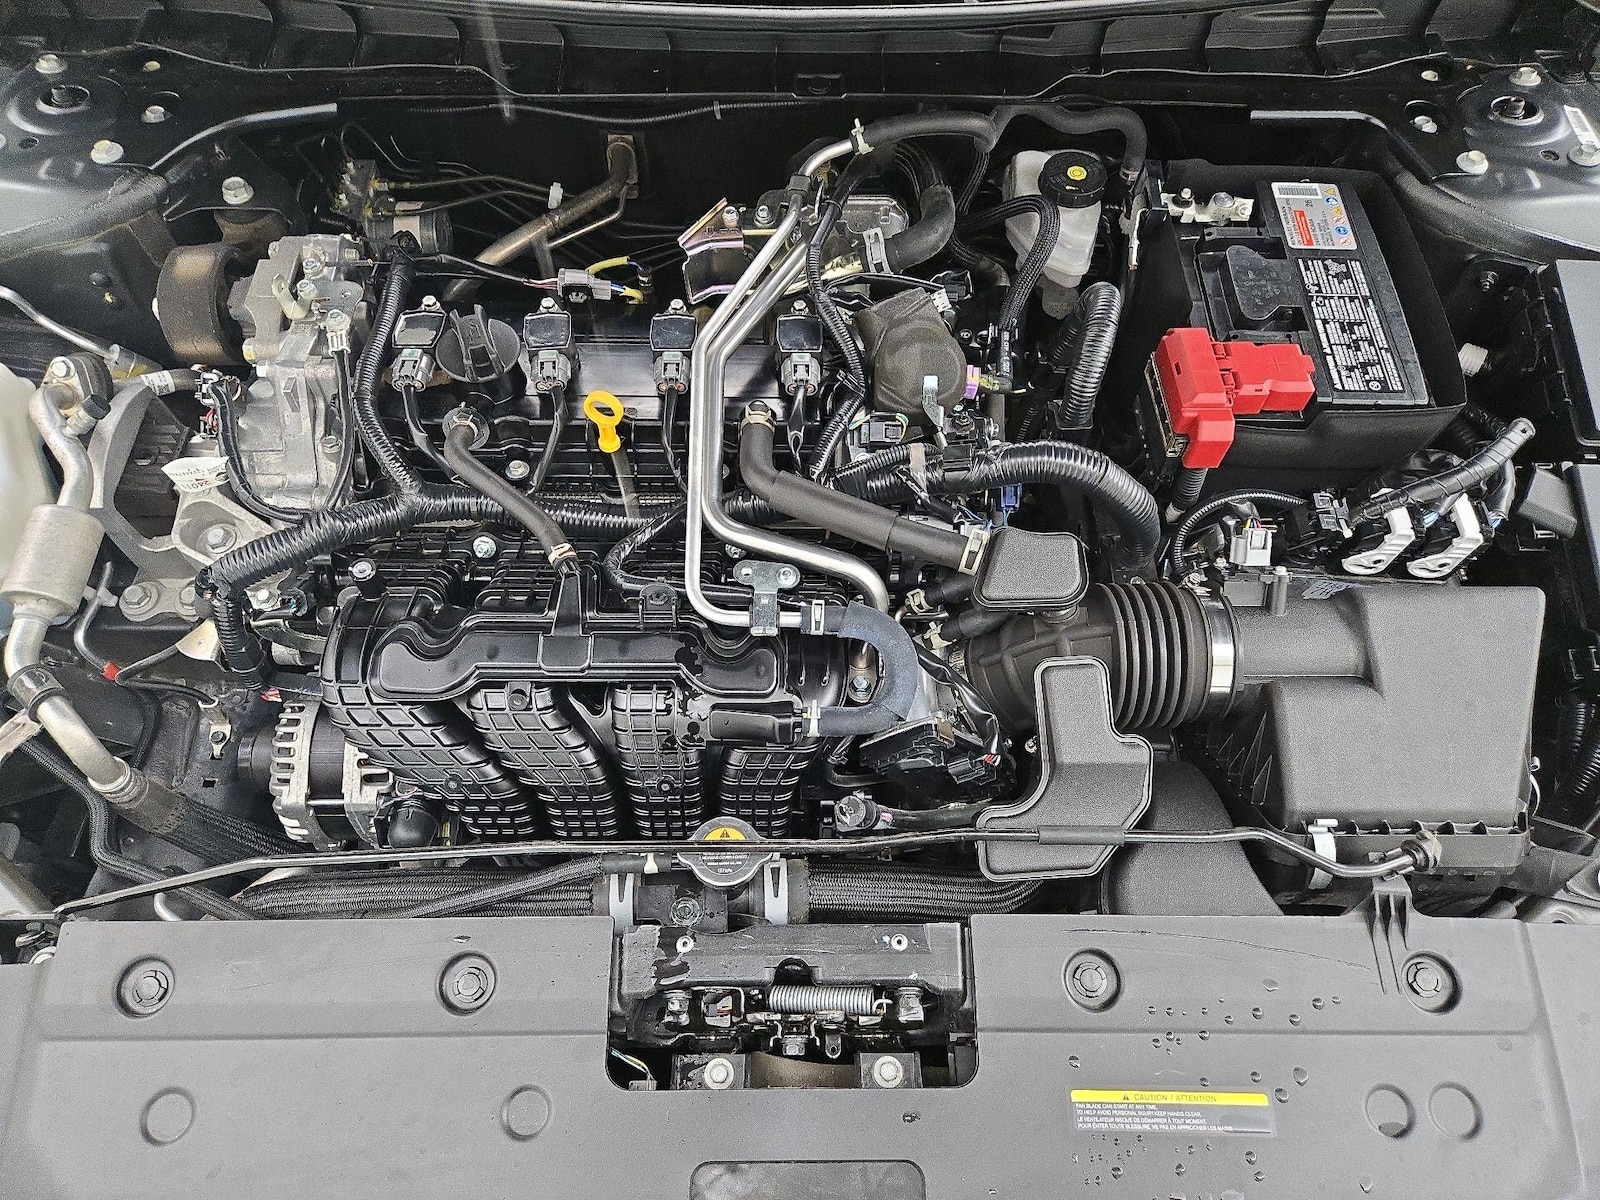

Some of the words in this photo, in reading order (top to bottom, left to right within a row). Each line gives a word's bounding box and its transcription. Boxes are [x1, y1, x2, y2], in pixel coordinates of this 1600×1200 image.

[1134, 1094, 1167, 1102] CAUTION
[1170, 1094, 1174, 1102] /
[1177, 1095, 1217, 1103] ATTENTION
